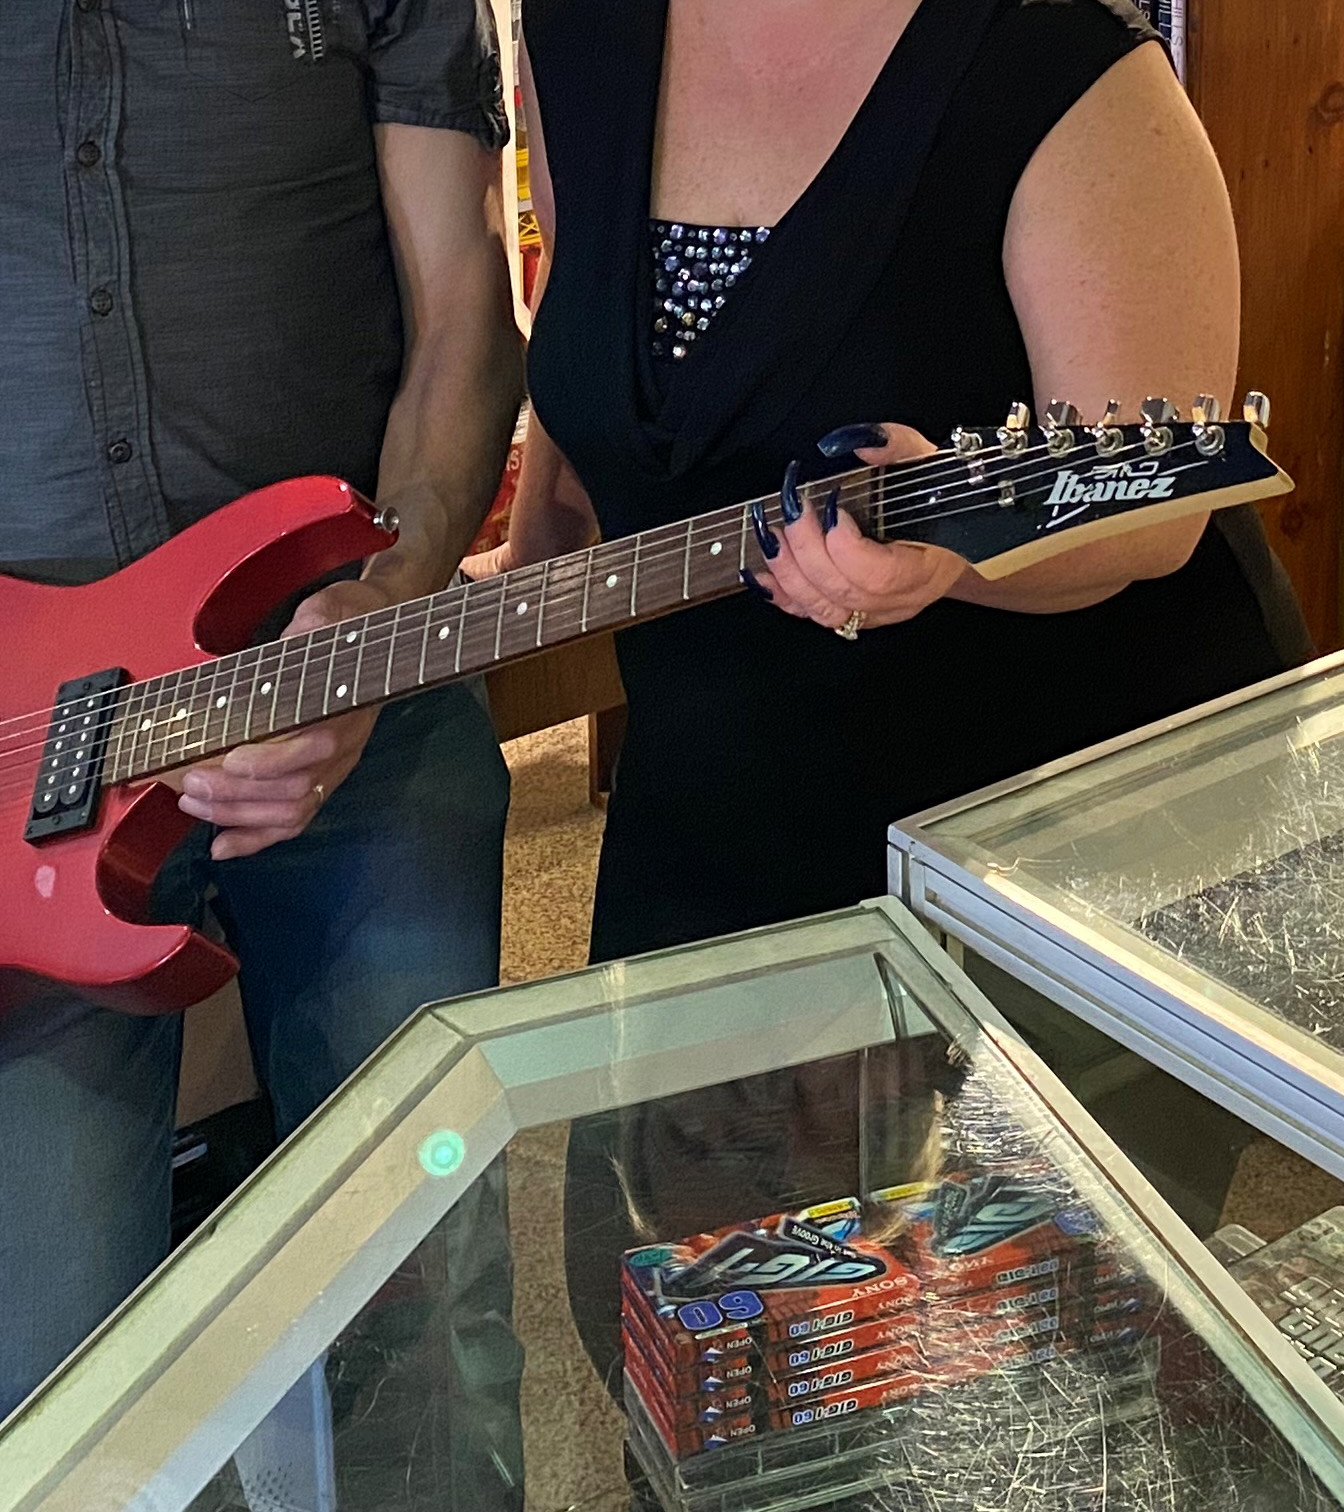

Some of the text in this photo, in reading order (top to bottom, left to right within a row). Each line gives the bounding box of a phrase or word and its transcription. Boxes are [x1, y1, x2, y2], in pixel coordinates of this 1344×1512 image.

[1043, 469, 1177, 508] Ibanez
[850, 1275, 909, 1300] SONY
[676, 1288, 764, 1333] 60
[725, 1337, 752, 1351] OPEN
[725, 1365, 752, 1379] OPEN
[725, 1396, 752, 1411] OPEN
[729, 1424, 755, 1438] OPEN
